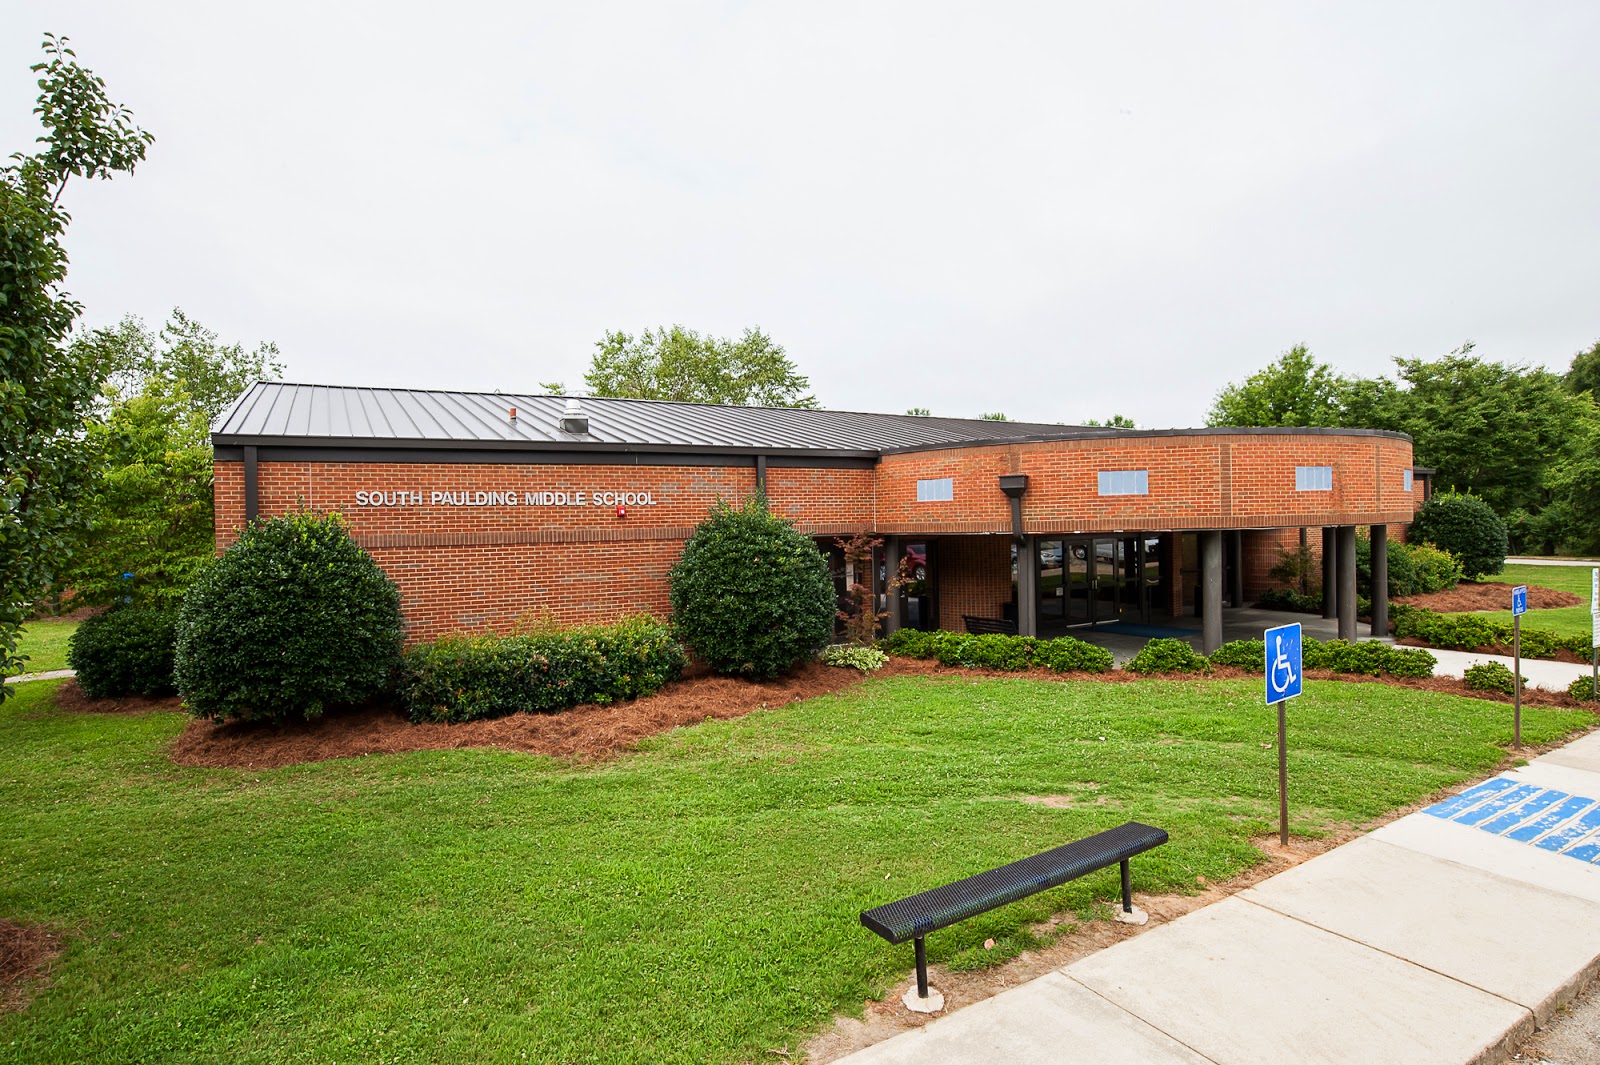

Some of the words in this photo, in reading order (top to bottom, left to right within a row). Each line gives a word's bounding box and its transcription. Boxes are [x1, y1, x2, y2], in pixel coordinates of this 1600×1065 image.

[355, 491, 423, 506] SOUTH
[431, 491, 518, 506] PAULDING
[525, 491, 586, 506] MIDDLE
[593, 491, 657, 506] SCHOOL
